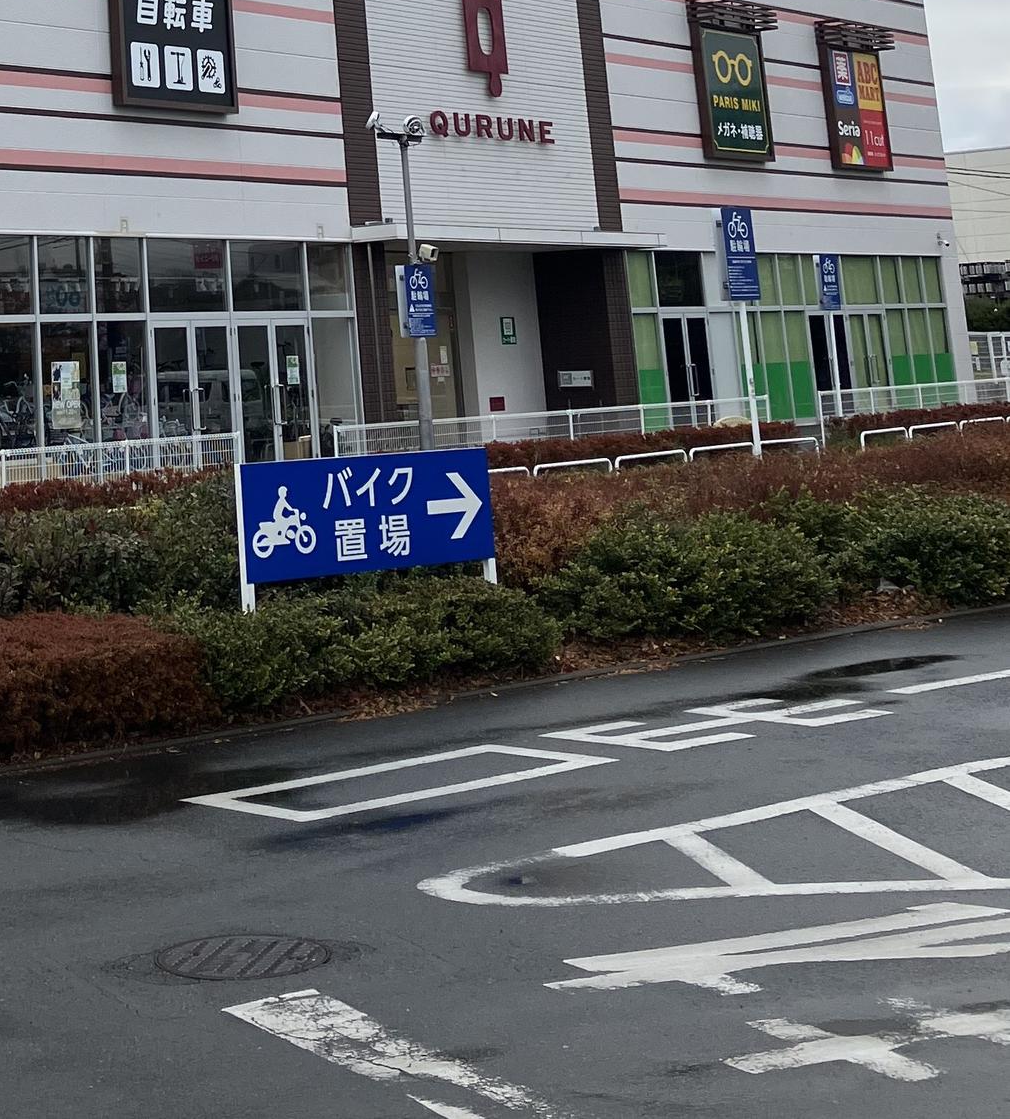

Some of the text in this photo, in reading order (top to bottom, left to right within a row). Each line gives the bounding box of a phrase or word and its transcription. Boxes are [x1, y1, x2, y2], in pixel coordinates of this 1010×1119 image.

[857, 60, 878, 85] ABC
[713, 94, 761, 112] PARIS MIKI
[858, 84, 880, 101] MART
[430, 110, 555, 144] QURUNE
[838, 120, 861, 137] Seria
[323, 466, 413, 509] バイク
[334, 514, 411, 562] 置場
